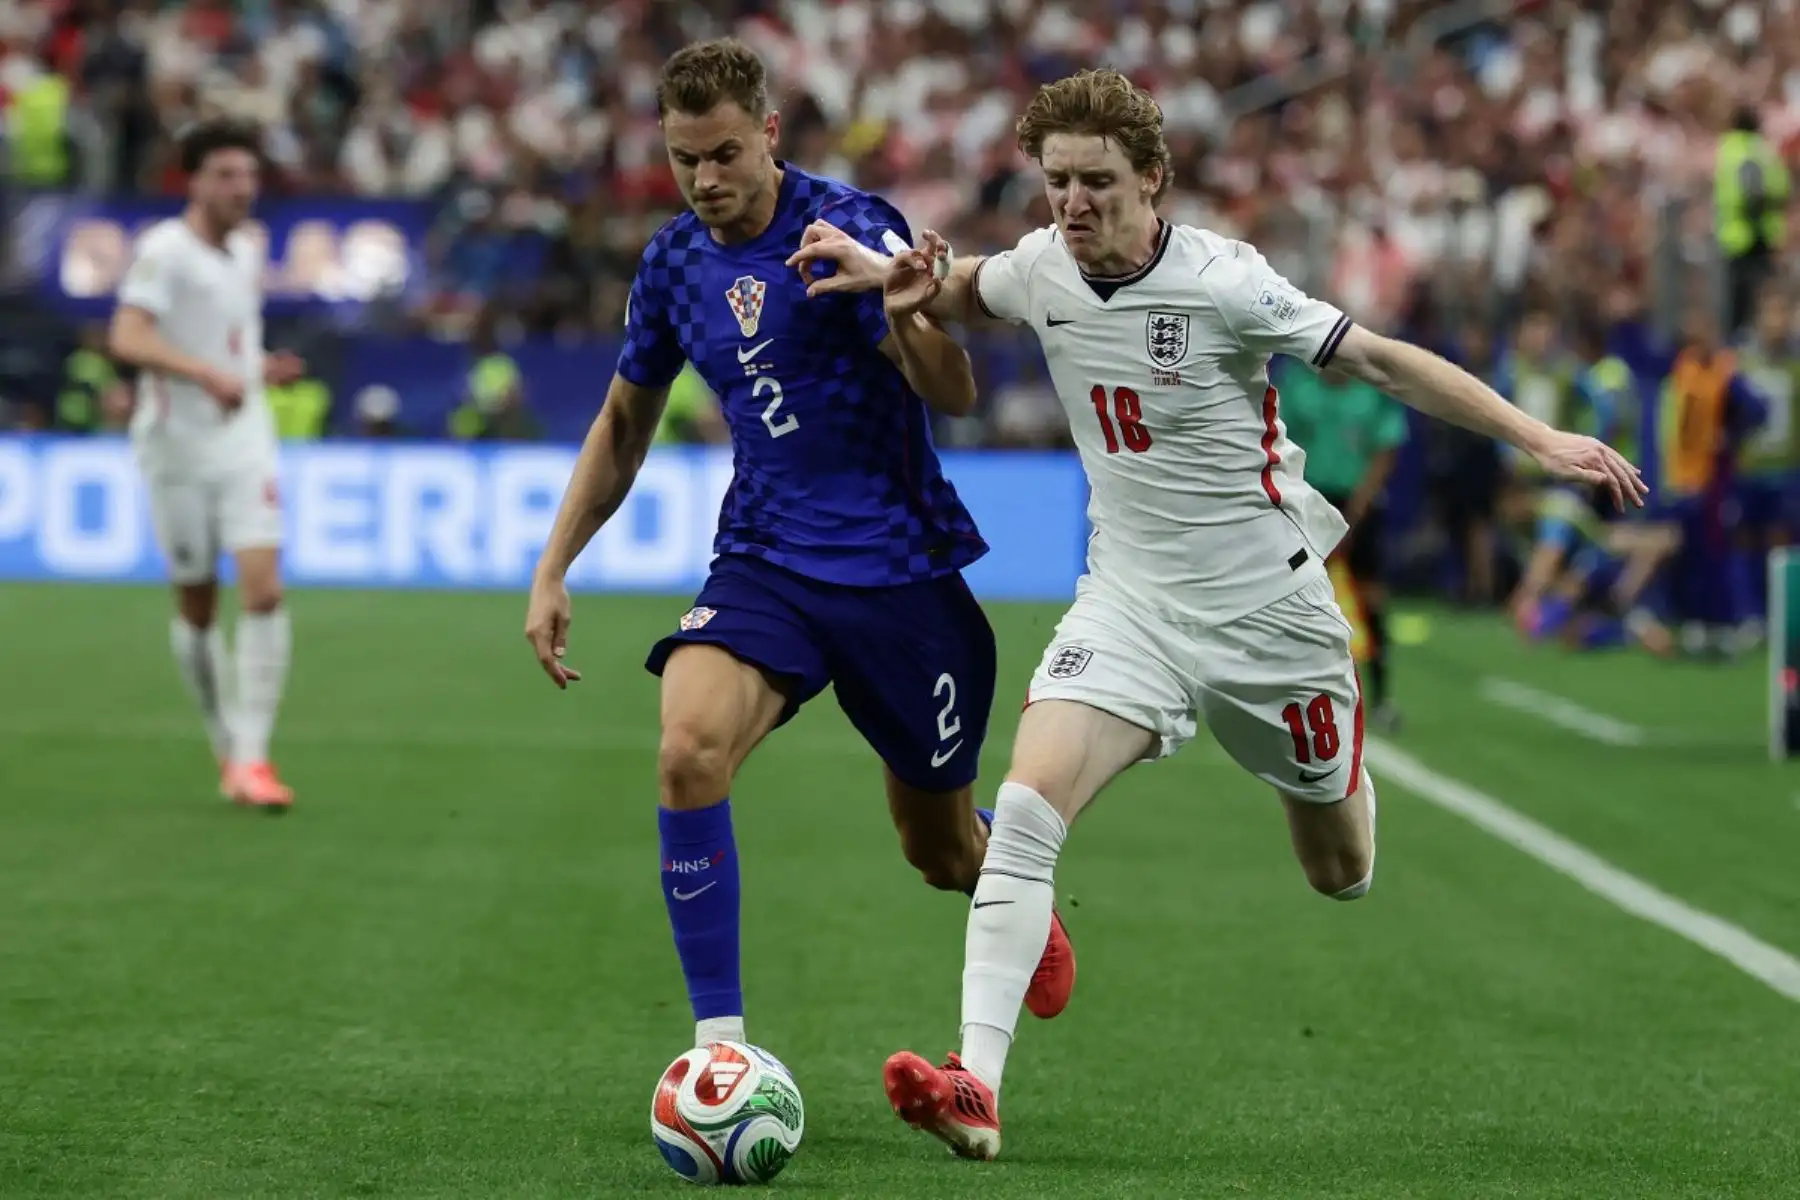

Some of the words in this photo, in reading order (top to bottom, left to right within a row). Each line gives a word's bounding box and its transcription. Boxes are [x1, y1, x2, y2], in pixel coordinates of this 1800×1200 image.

[752, 376, 800, 438] 2
[1090, 384, 1153, 453] 18
[0, 443, 738, 579] OERAD
[933, 672, 960, 741] 2
[1282, 693, 1340, 764] 18
[672, 857, 710, 873] HNS
